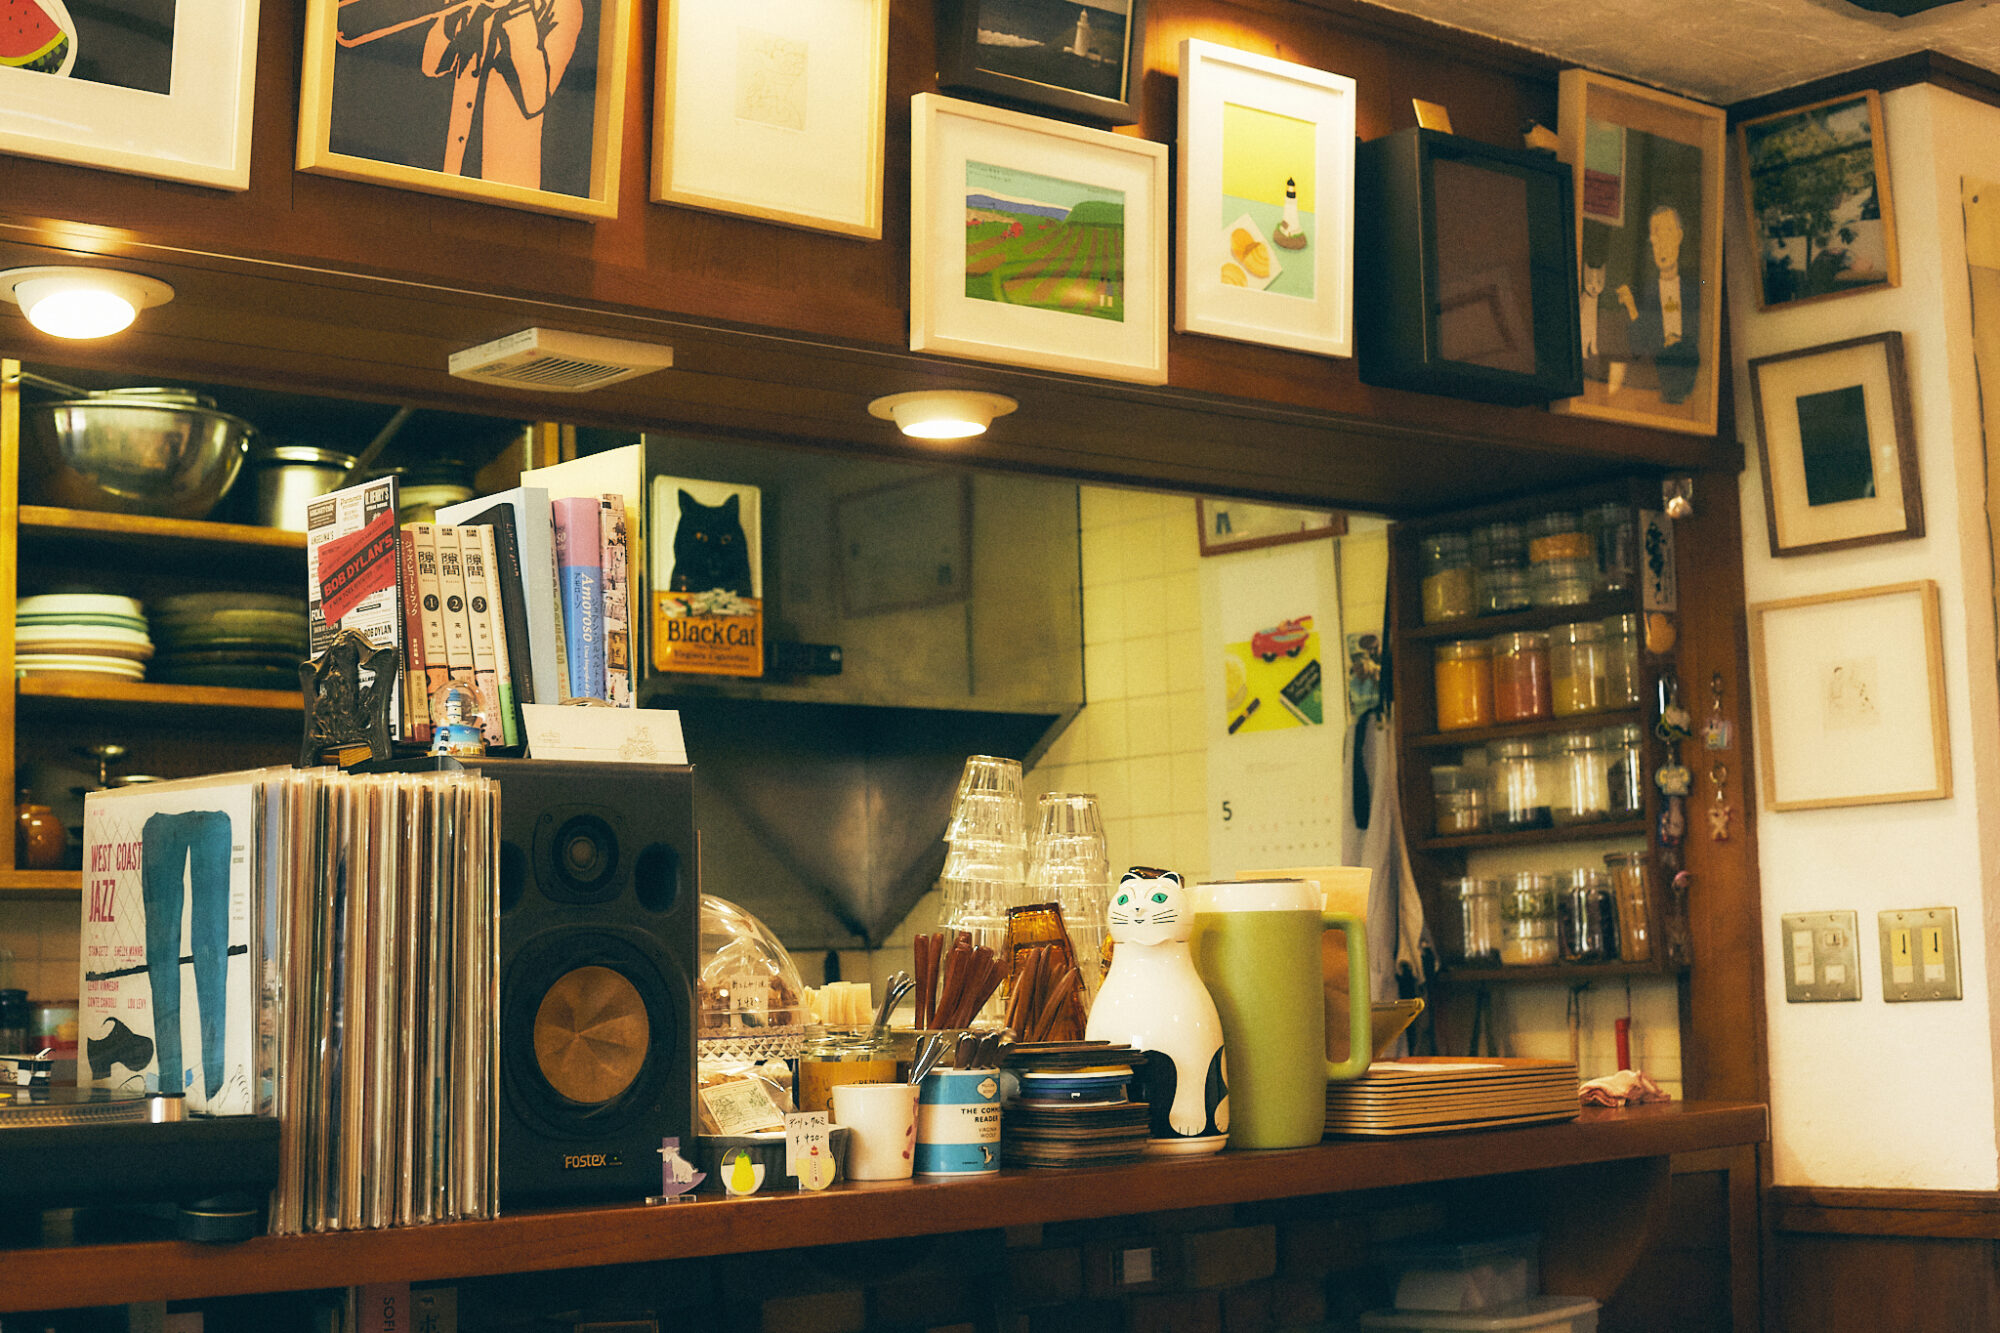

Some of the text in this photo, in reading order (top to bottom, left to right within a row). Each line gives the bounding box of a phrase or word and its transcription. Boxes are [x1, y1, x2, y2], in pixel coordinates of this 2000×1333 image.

[323, 572, 346, 598] BOB
[346, 533, 394, 579] DYLAN'S
[581, 573, 594, 642] Amoroso
[364, 624, 392, 639] BOB DYLAN
[668, 620, 755, 647] Black Cat
[1222, 801, 1232, 821] 5
[91, 841, 143, 873] WEST COAST
[89, 879, 116, 923] JAZZ
[961, 1107, 978, 1115] THE
[974, 1115, 999, 1123] READER
